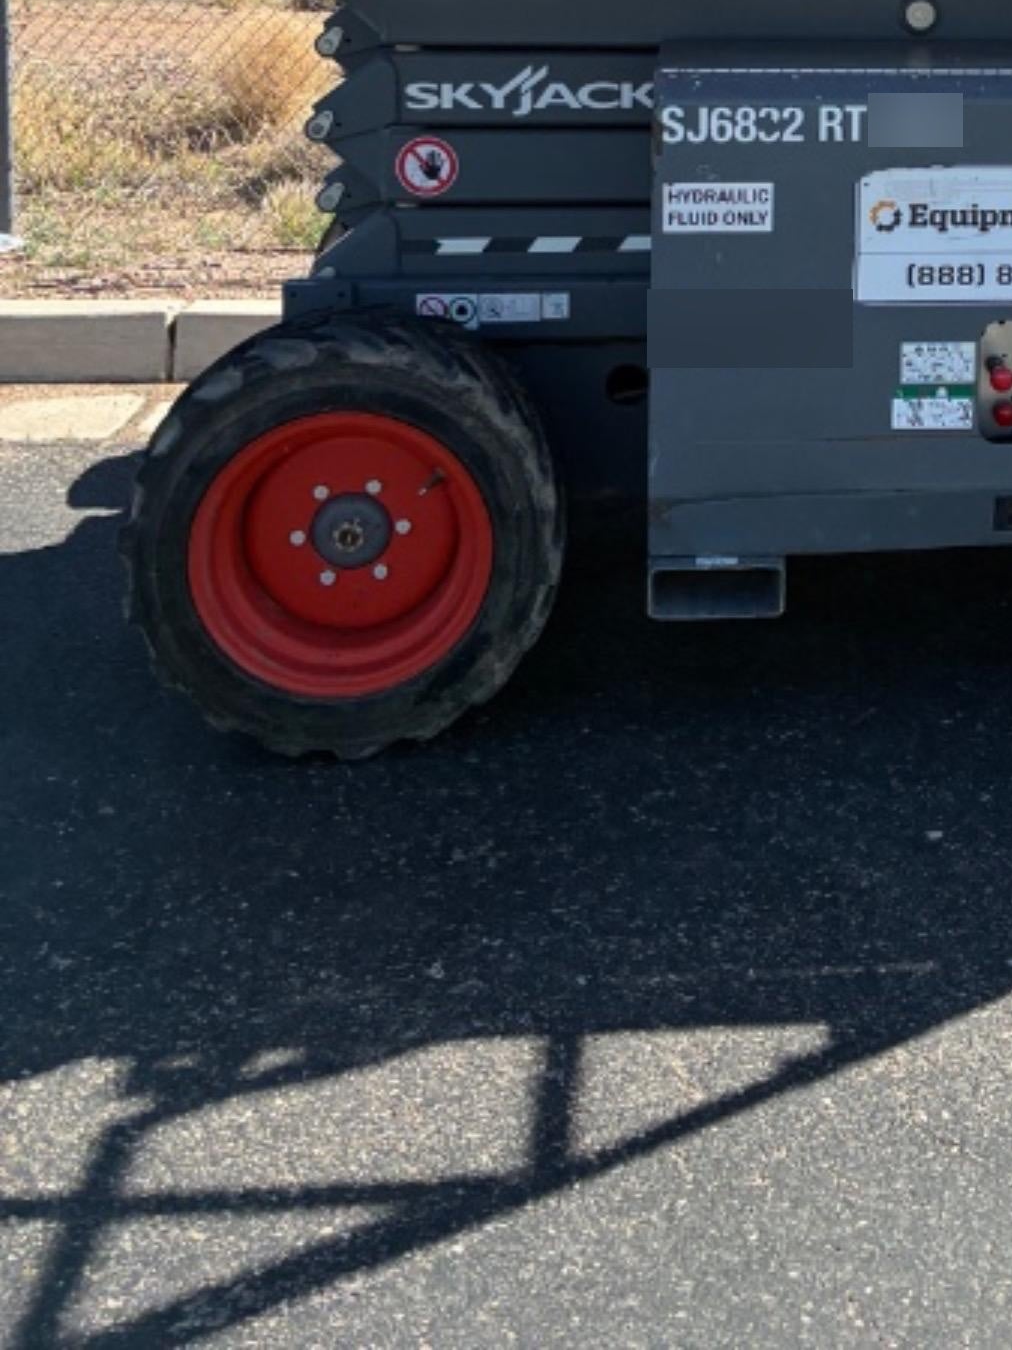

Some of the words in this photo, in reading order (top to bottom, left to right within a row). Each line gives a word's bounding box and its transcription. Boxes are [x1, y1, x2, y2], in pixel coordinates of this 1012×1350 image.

[817, 104, 868, 143] RT
[668, 187, 770, 204] HYDRAULIC
[668, 210, 719, 226] FLUID
[722, 209, 769, 226] ONLY
[906, 262, 985, 288] (888)
